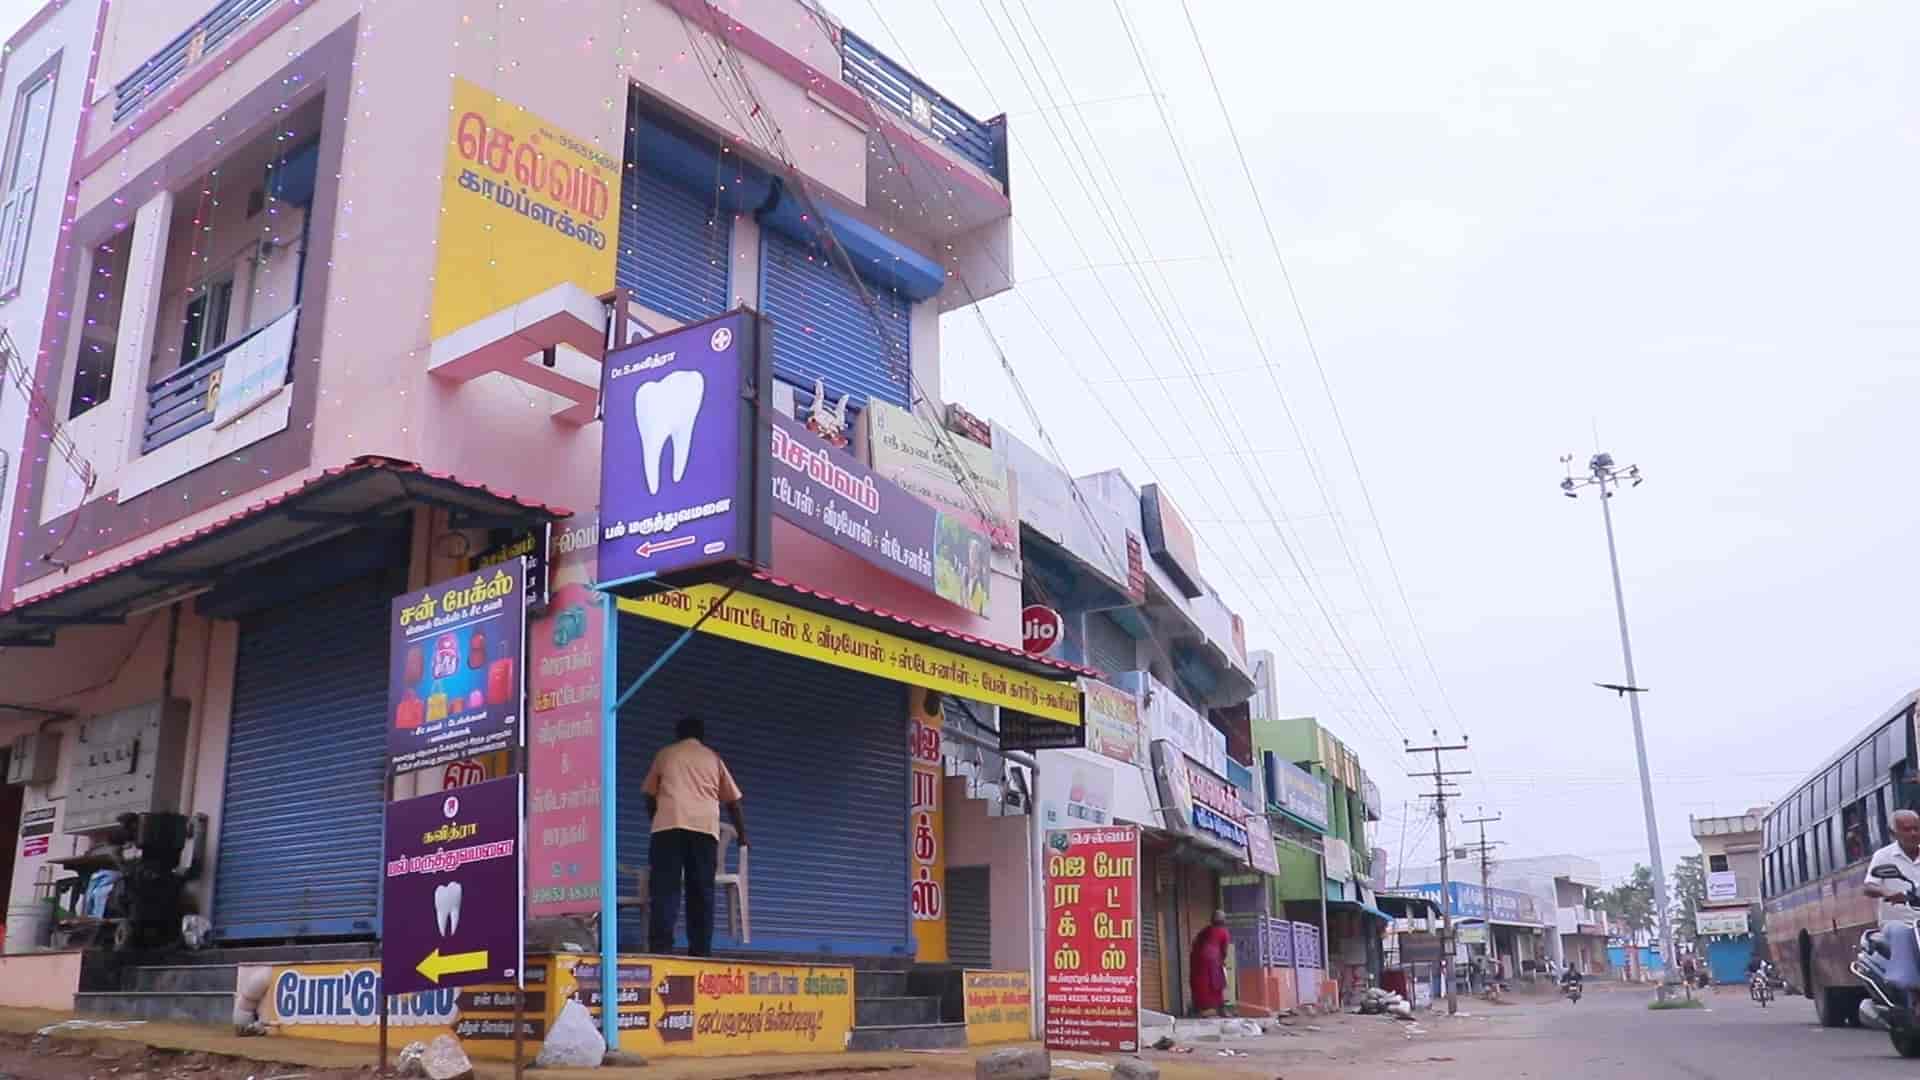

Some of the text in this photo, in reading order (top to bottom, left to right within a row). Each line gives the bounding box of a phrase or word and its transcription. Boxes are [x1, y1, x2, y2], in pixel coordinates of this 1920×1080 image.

[457, 112, 609, 221] செல்வம்
[628, 499, 730, 535] மருத்துவமனை
[772, 476, 815, 517] ட்டோஸ்
[400, 593, 437, 626] சன்
[443, 569, 513, 612] பேக்ஸ்
[709, 596, 798, 640] போட்டோஸ்
[801, 623, 813, 645] &
[1023, 618, 1055, 640] Jio
